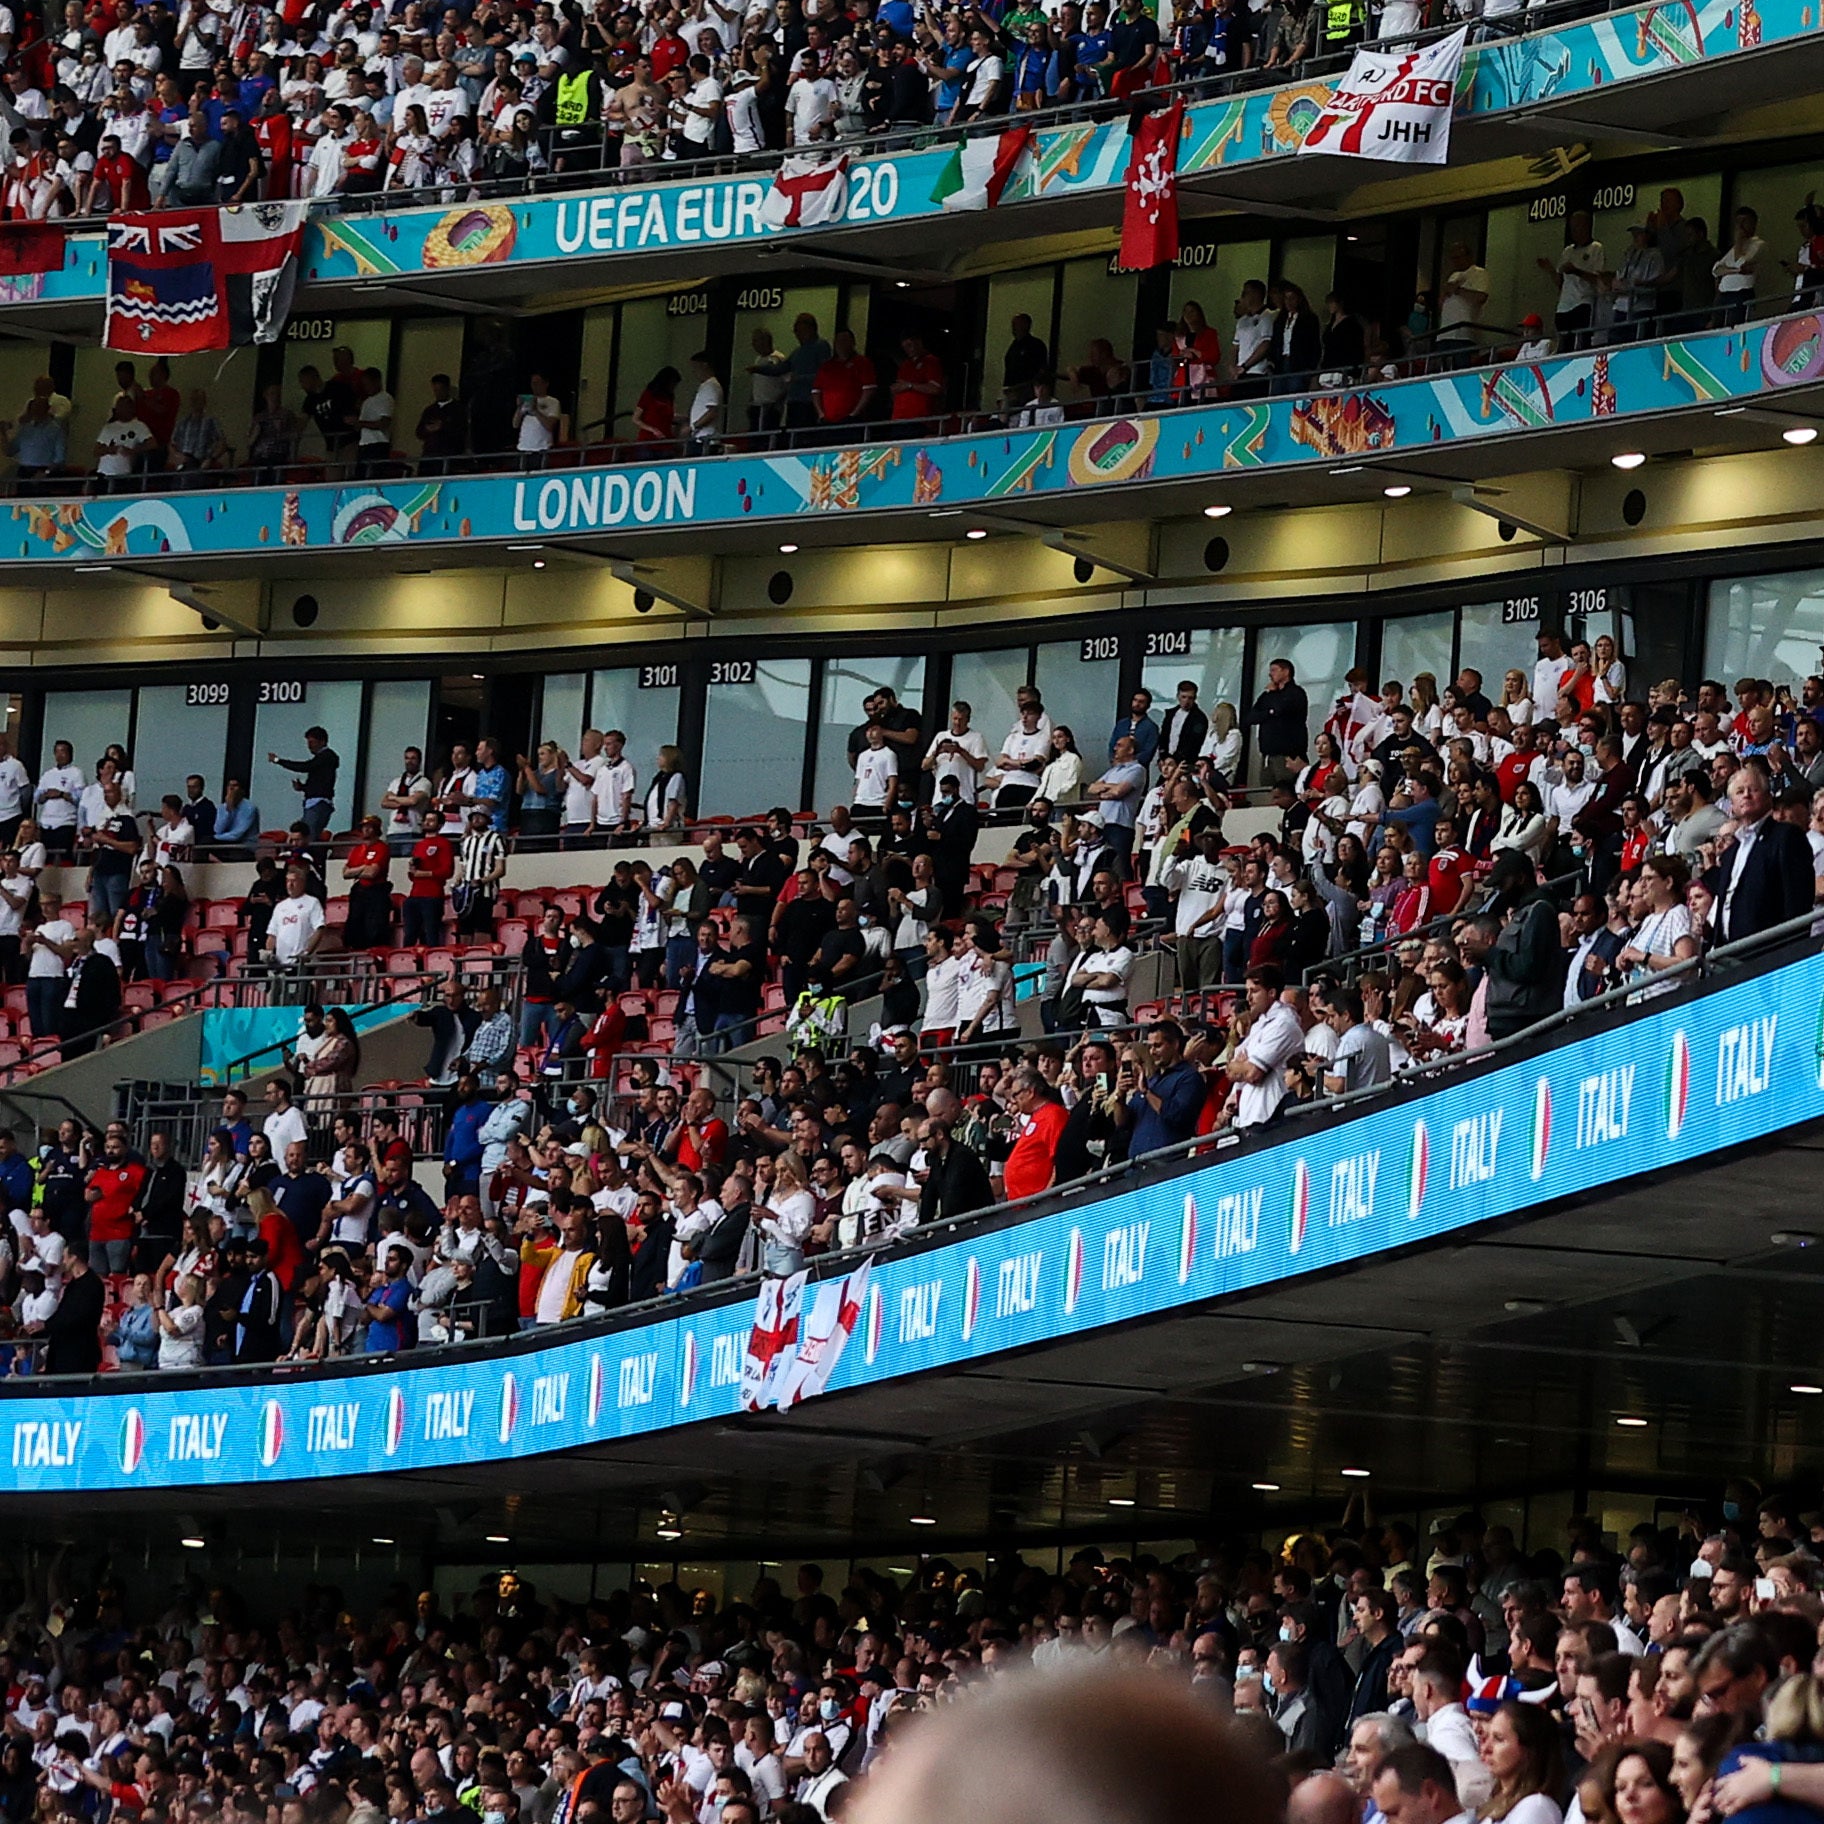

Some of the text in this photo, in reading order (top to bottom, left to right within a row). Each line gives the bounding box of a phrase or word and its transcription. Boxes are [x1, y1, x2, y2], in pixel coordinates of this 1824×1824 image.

[1414, 82, 1448, 105] FC
[1378, 120, 1432, 144] JHH
[556, 162, 898, 253] UEFA EUR 20
[1529, 183, 1634, 220] 4008 4009
[668, 287, 783, 316] 4004 4005
[287, 319, 333, 339] 4003
[514, 468, 697, 531] LONDON
[1505, 589, 1607, 622] 3105 3106
[1083, 631, 1187, 660] 3103 3104
[187, 680, 302, 704] 3099 3100
[643, 661, 752, 687] 3101 3102
[1715, 1014, 1778, 1106] ITALY
[1575, 1065, 1636, 1150] ITALY
[1449, 1107, 1505, 1190] ITALY
[1328, 1148, 1381, 1227] ITALY
[1213, 1187, 1265, 1259] ITALY
[1101, 1221, 1151, 1291] ITALY
[995, 1249, 1044, 1318] ITALY
[898, 1279, 943, 1343] ITALY
[531, 1372, 570, 1426] ITALY
[617, 1352, 659, 1408] ITALY
[168, 1413, 228, 1460] ITALY
[307, 1403, 360, 1452] ITALY
[424, 1389, 475, 1440] ITALY
[12, 1421, 82, 1467] ITALY
